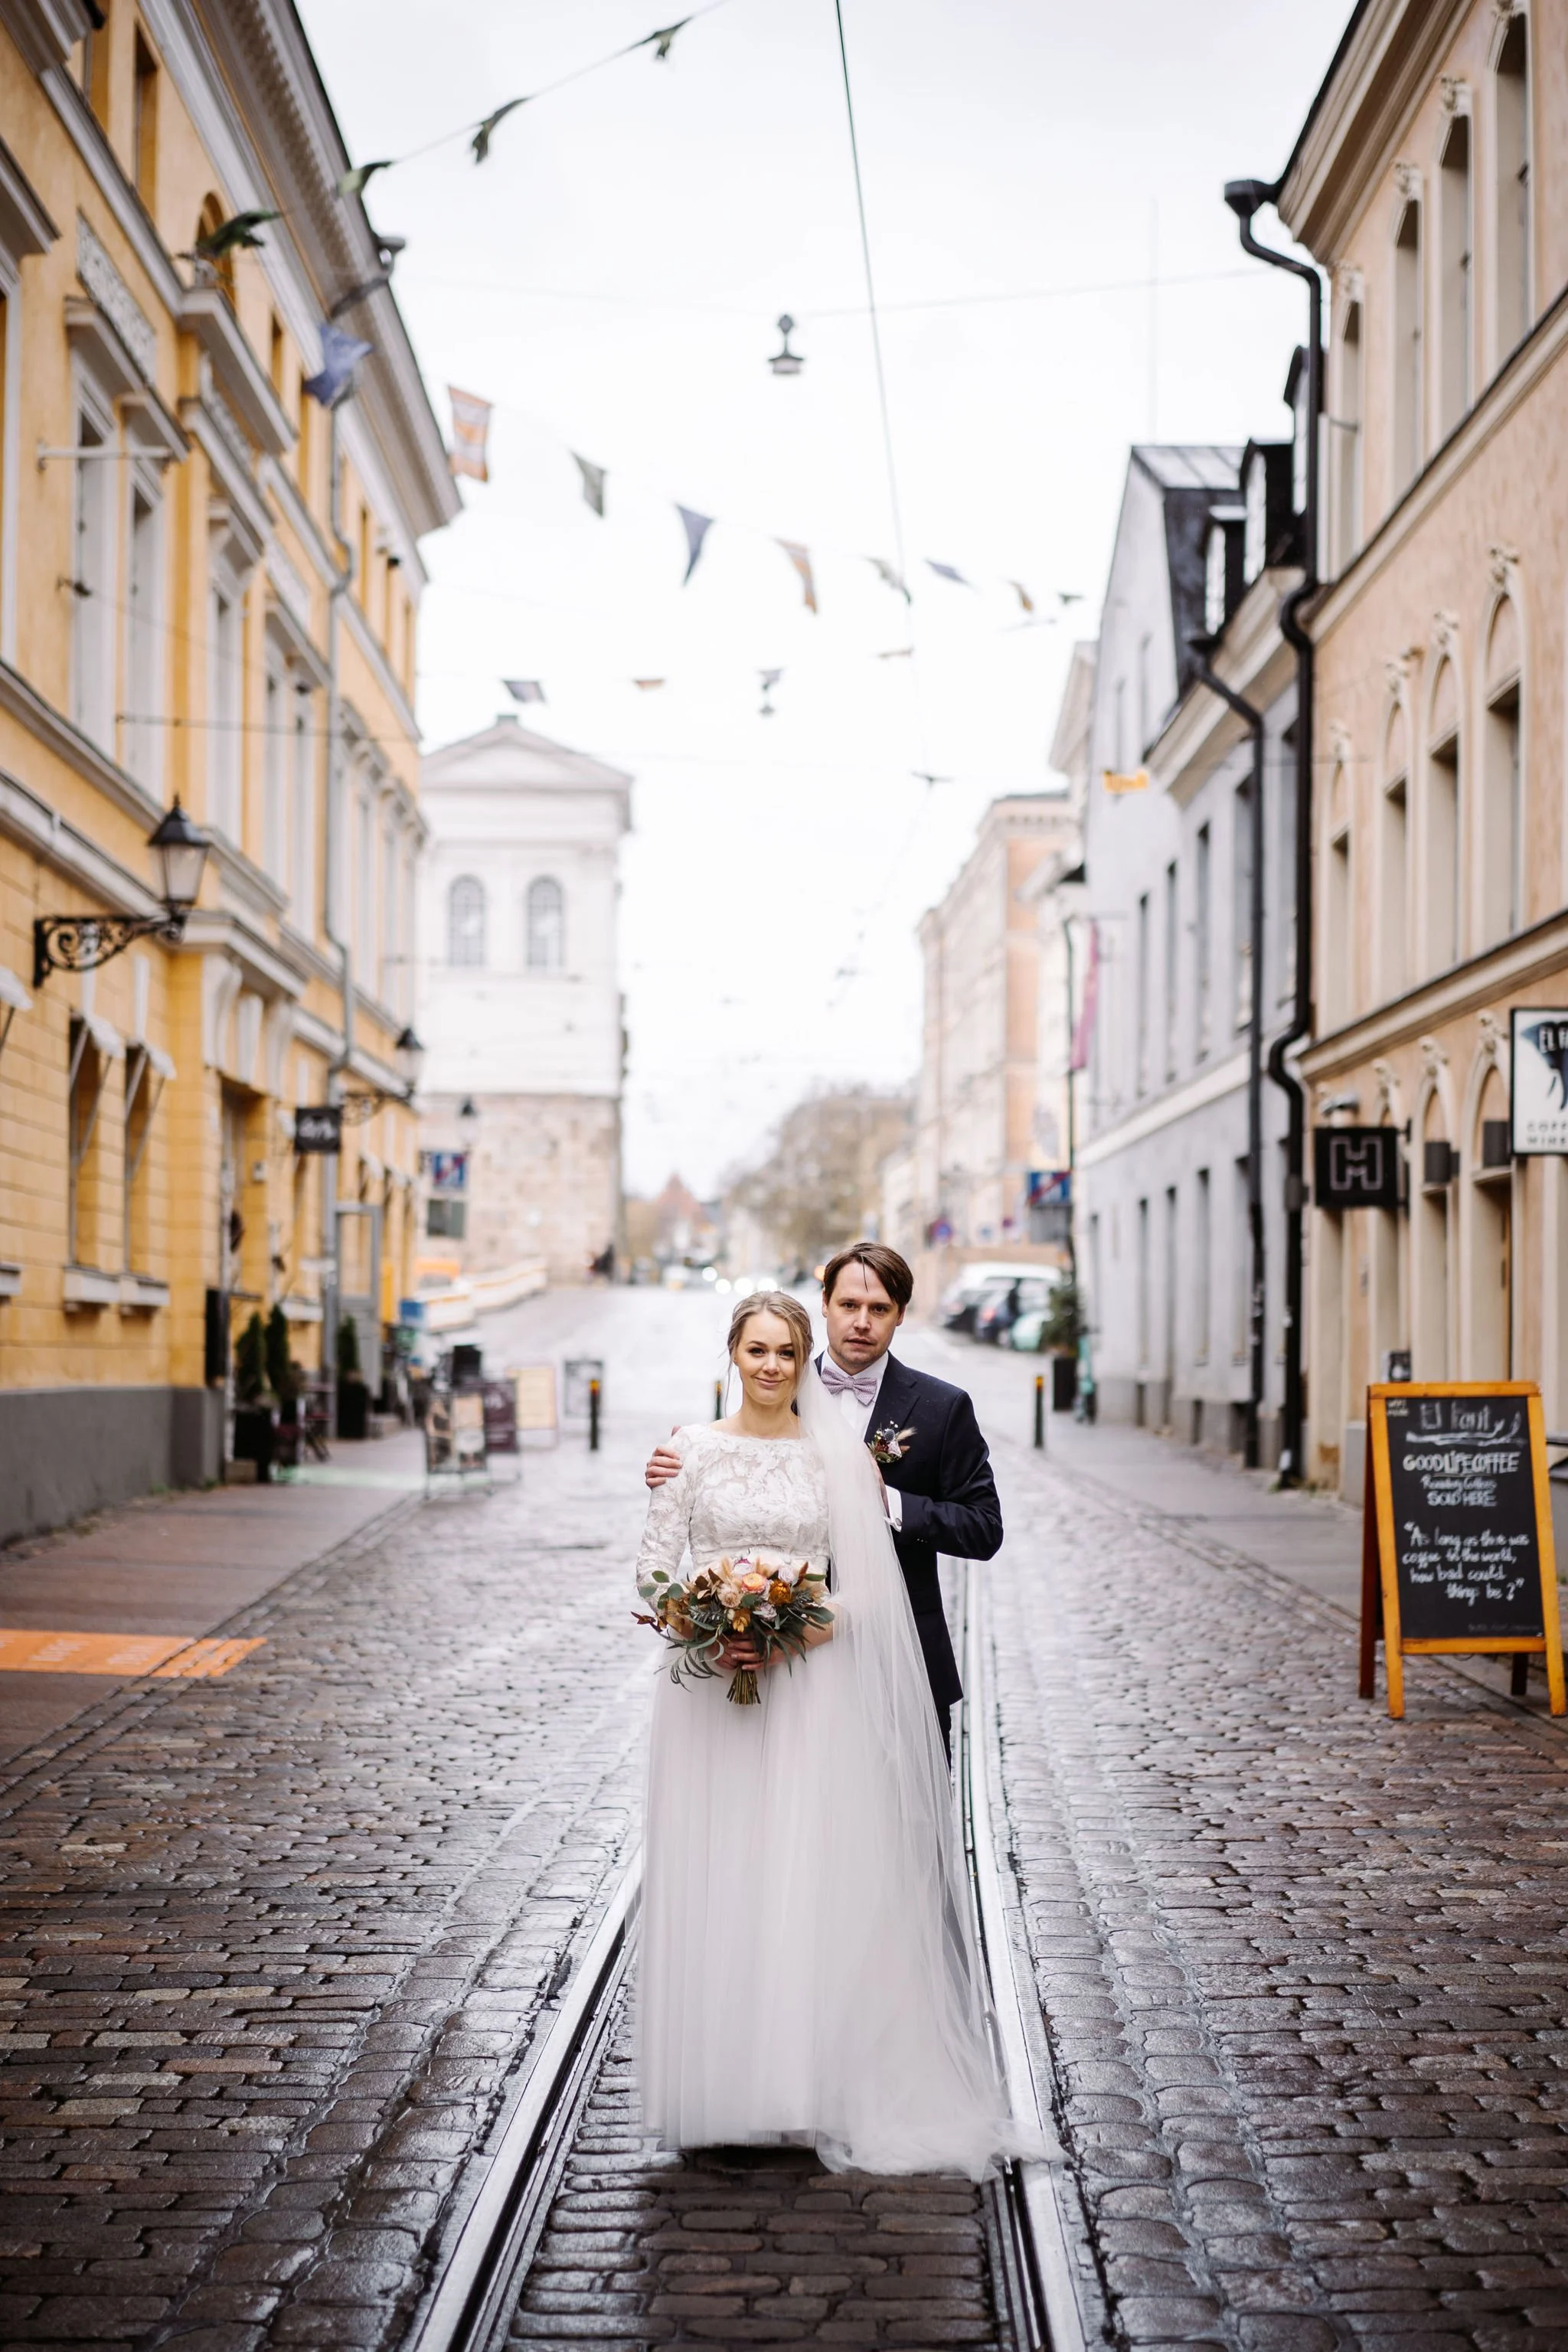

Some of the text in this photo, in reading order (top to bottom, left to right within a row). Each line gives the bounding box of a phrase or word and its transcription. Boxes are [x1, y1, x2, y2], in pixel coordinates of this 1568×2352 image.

[1539, 1026, 1557, 1054] EL
[1330, 1135, 1383, 1191] H
[1427, 1490, 1498, 1507] SOLD HERE
[1435, 1526, 1462, 1551] long
[1463, 1535, 1480, 1547] as
[1508, 1534, 1530, 1547] was
[1402, 1550, 1441, 1569] coffee
[1461, 1547, 1479, 1562] the
[1410, 1561, 1507, 1583] how bad could
